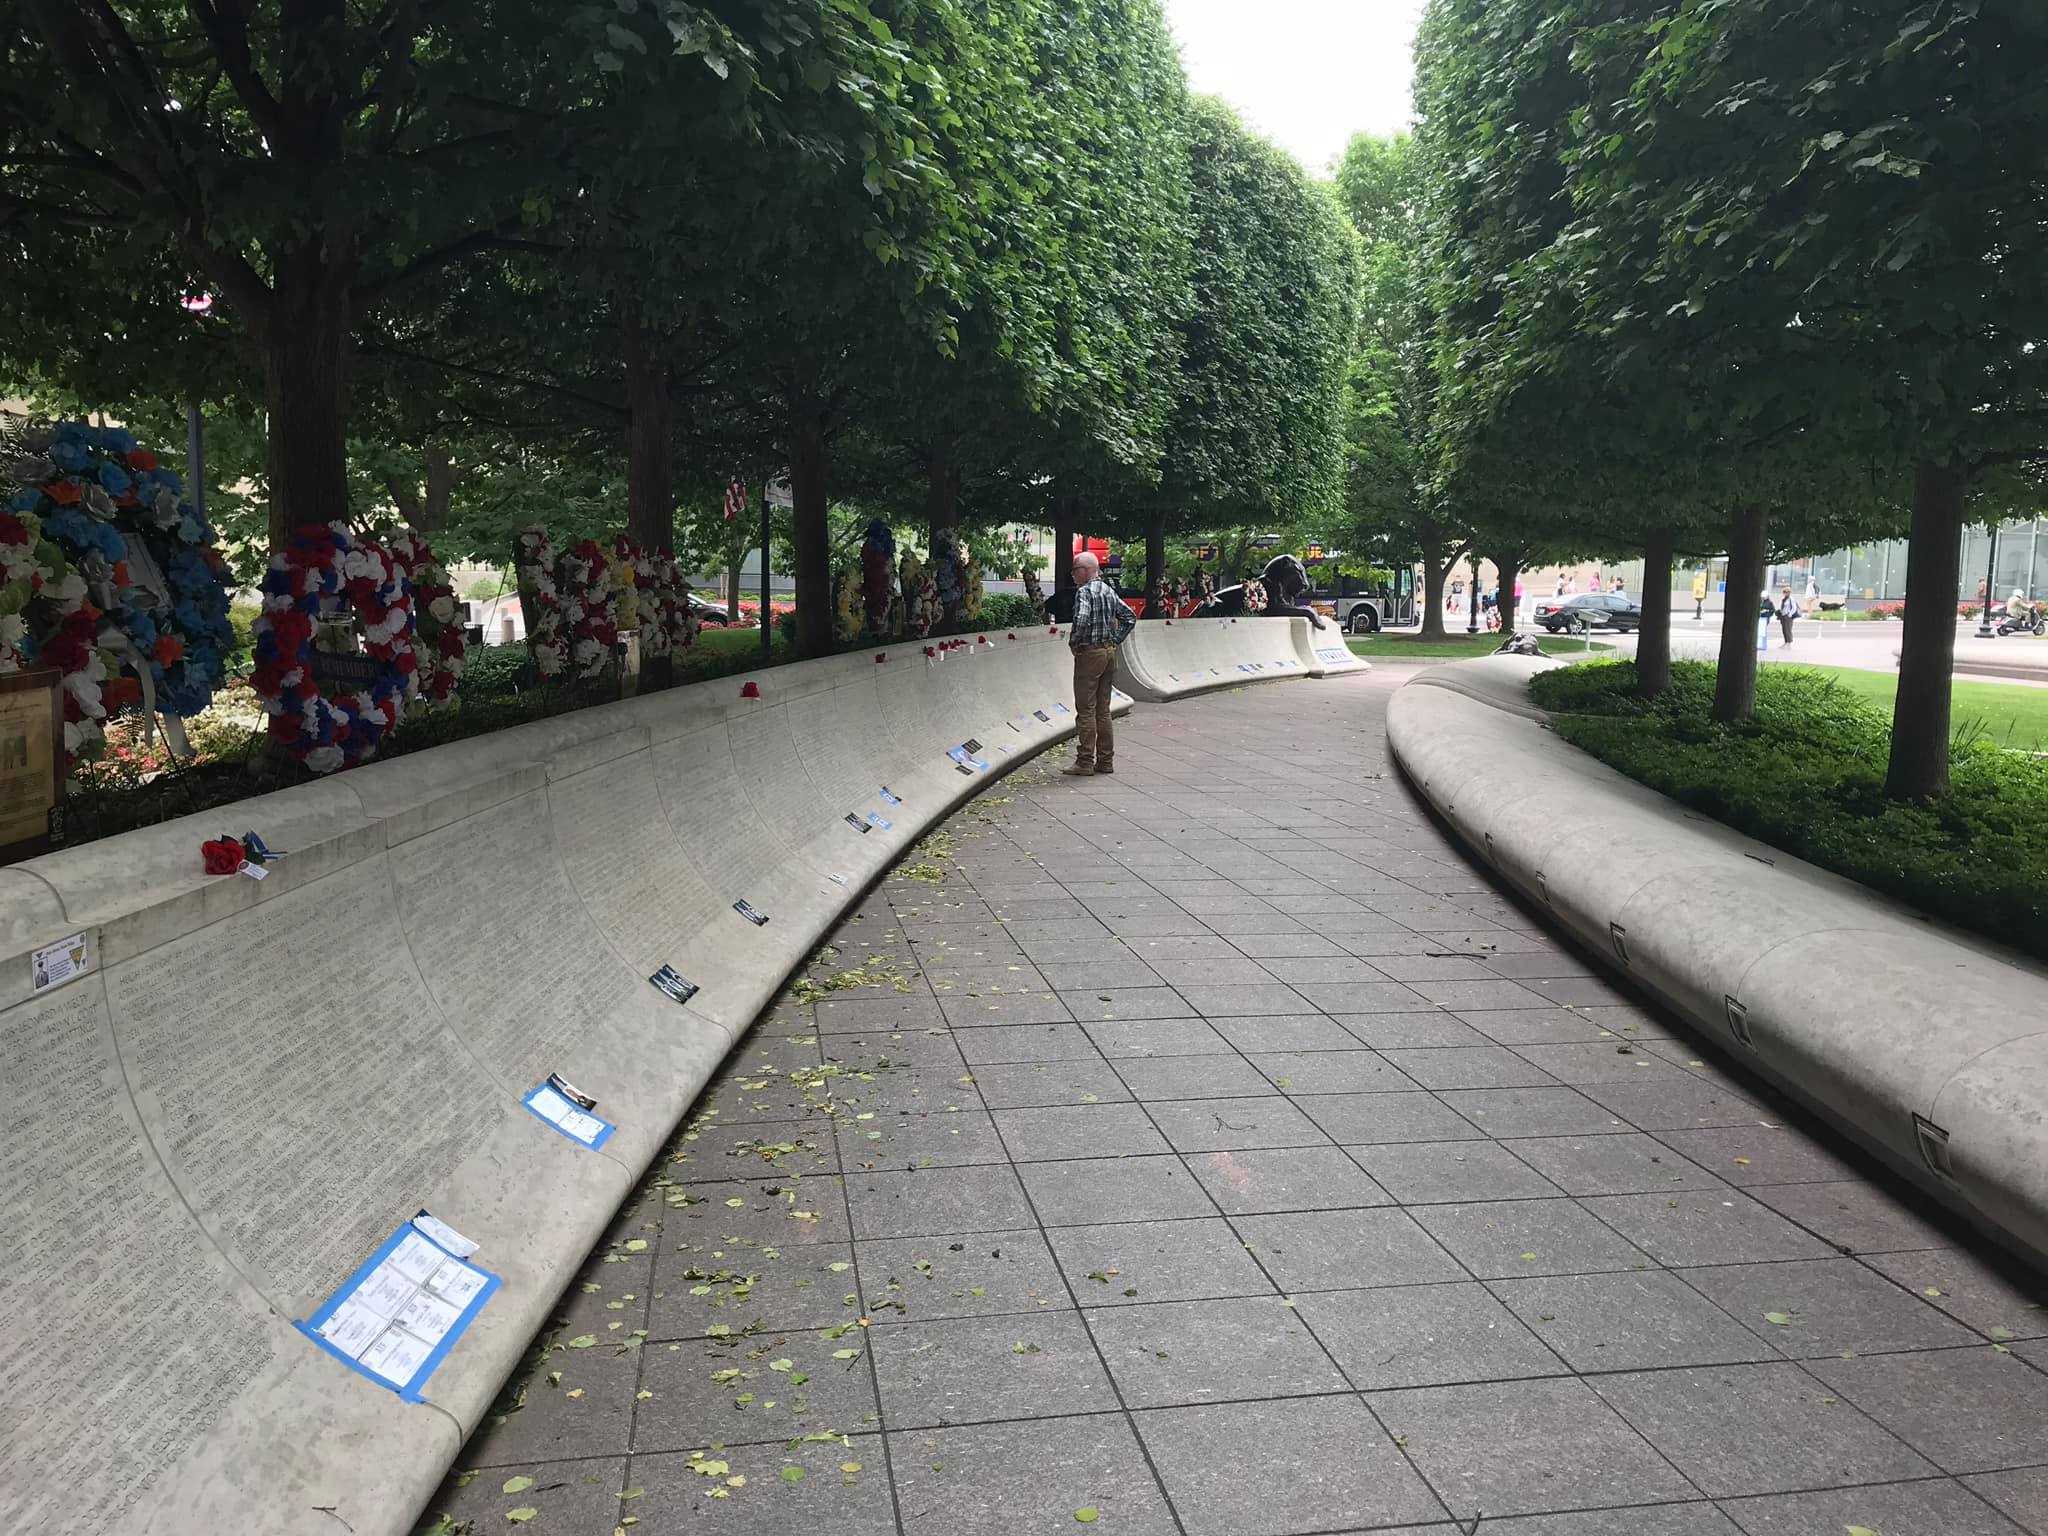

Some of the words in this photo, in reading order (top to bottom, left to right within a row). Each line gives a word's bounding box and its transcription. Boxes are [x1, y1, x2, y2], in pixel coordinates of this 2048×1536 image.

[123, 1463, 163, 1506] CLINTON
[164, 1409, 217, 1464] GREENWOOD
[146, 1423, 181, 1460] NELSON
[178, 1391, 214, 1427] DONALD
